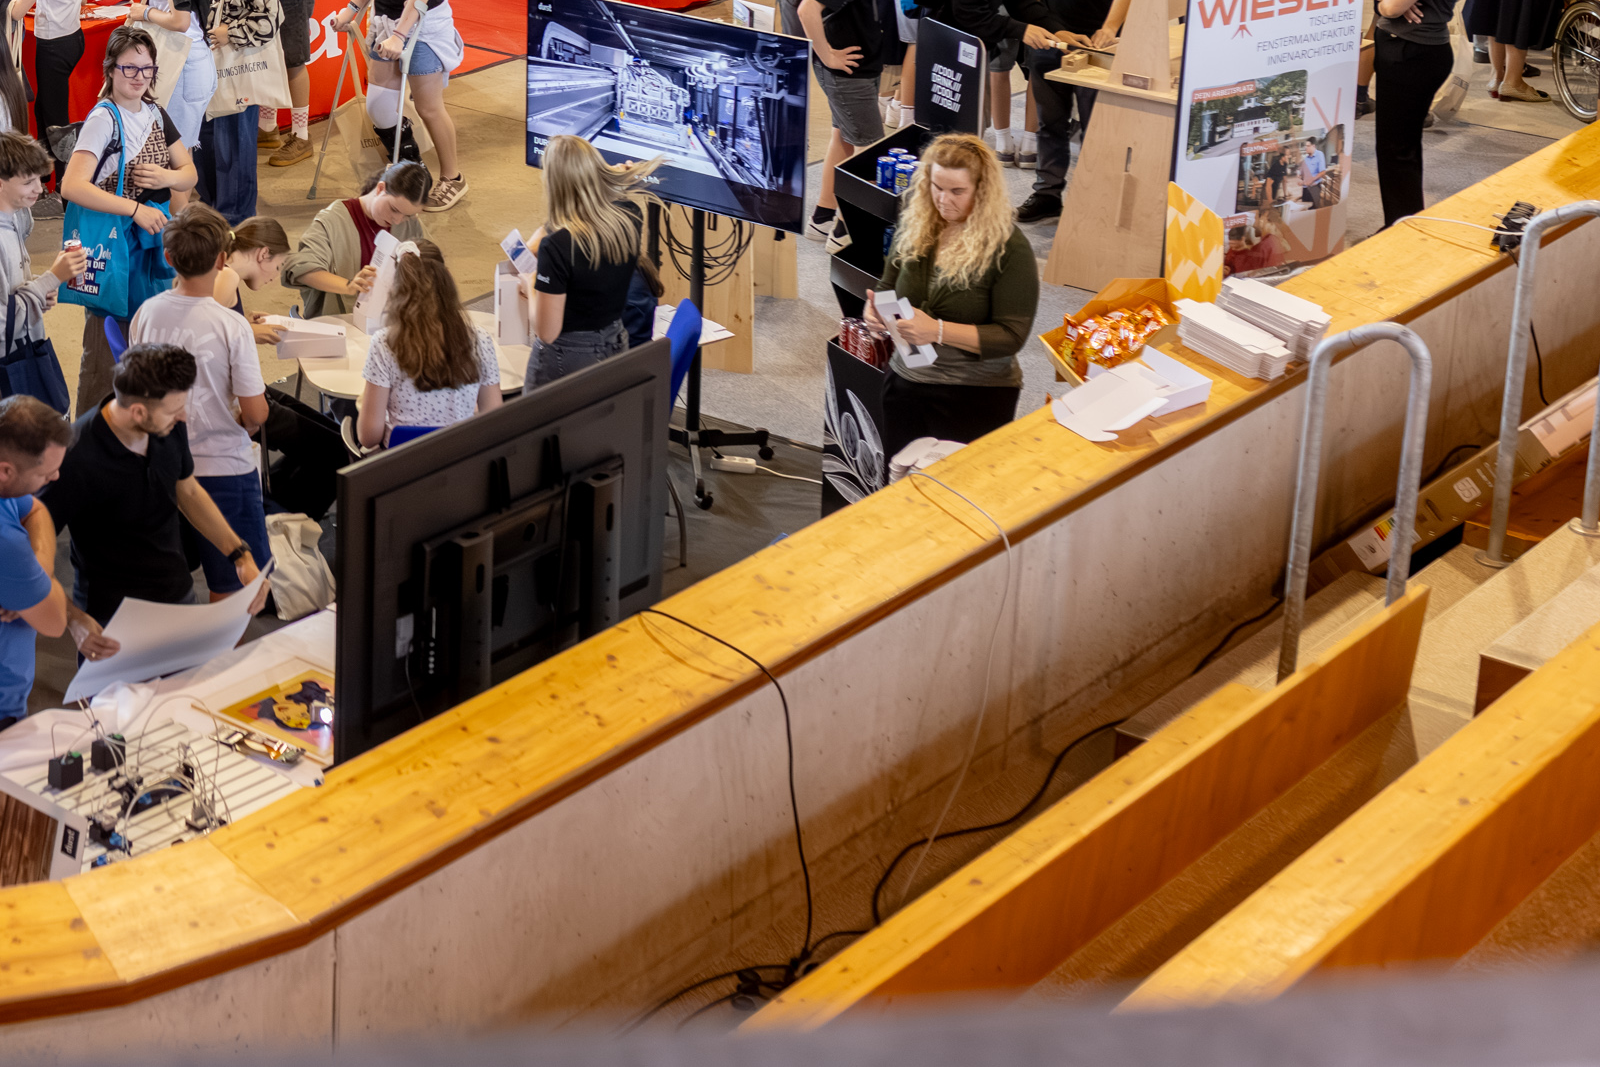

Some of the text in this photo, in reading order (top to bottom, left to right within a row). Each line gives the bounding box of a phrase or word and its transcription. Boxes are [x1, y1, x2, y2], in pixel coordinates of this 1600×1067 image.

[1308, 10, 1357, 26] TISCHLEREI
[1256, 25, 1355, 53] FENSTERMANUFAKTUR
[1267, 41, 1355, 67] INNENARCHITEKTUR
[1194, 84, 1254, 100] DEIN ARBEITSPLATZ
[93, 260, 105, 270] DIE
